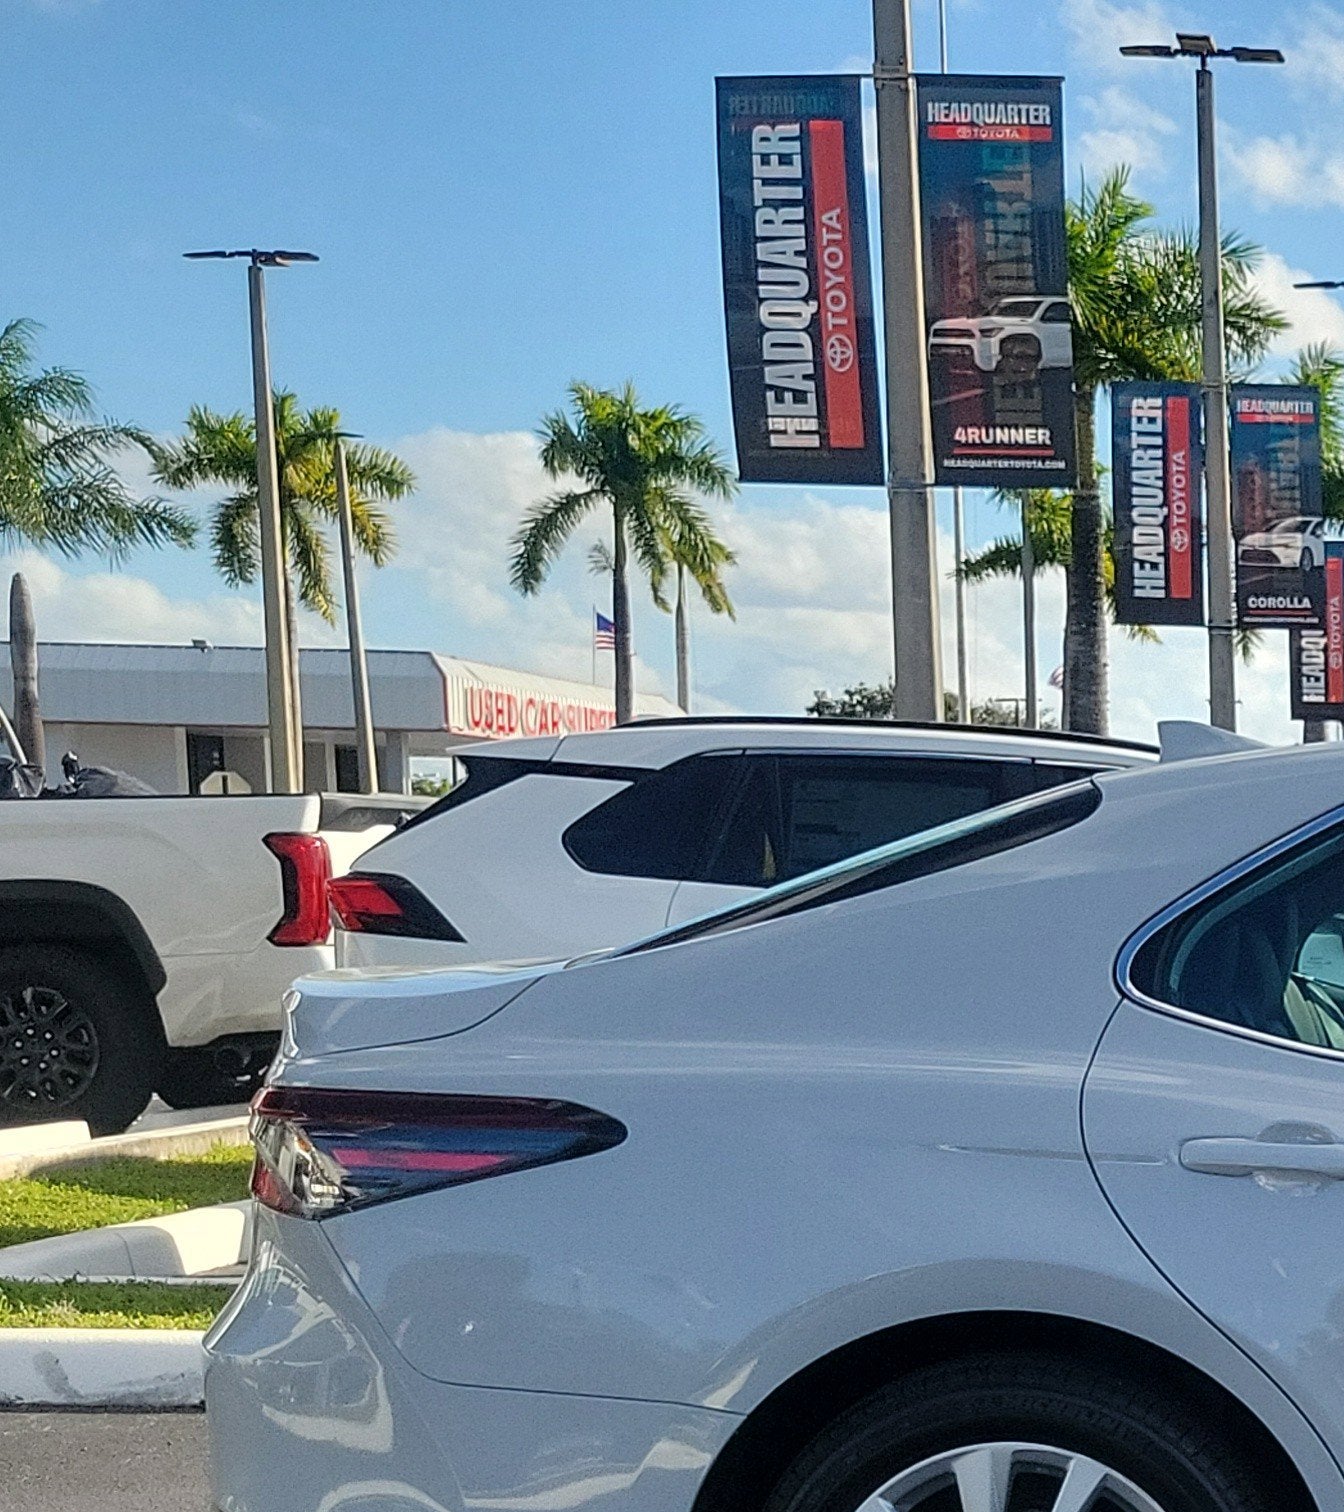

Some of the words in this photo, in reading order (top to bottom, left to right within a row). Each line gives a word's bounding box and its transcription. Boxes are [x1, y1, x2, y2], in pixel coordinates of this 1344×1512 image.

[927, 101, 1051, 126] HEADQUARTER
[973, 128, 1020, 138] TOYOTA
[752, 123, 821, 448] HEADQUARTER
[821, 207, 850, 330] TOYOTA
[953, 426, 1052, 445] 4RUNNER
[1131, 397, 1168, 599] HEADQUARTER
[1172, 451, 1187, 527] TOYOTA
[1247, 595, 1312, 609] COROLLA
[1330, 597, 1342, 650] TOYOTA
[467, 686, 519, 734] USED
[523, 698, 561, 735] CAR
